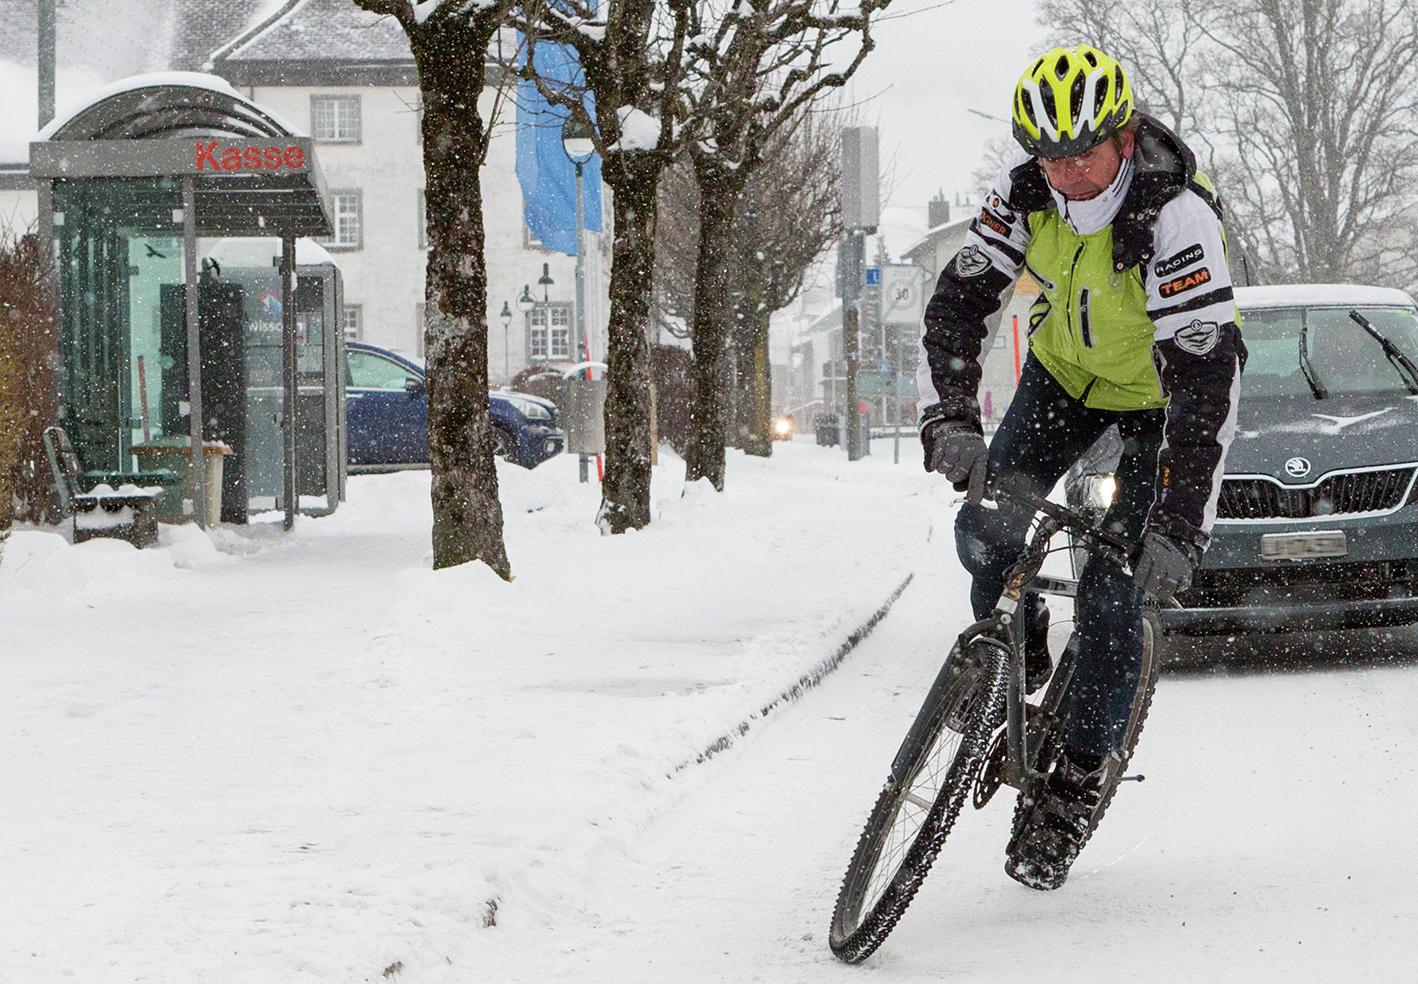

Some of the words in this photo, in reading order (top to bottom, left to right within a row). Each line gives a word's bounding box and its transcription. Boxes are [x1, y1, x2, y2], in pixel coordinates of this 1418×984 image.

[195, 140, 304, 171] Kasse
[1156, 249, 1202, 273] RACING
[895, 288, 909, 300] 30
[1161, 271, 1209, 294] TEAM
